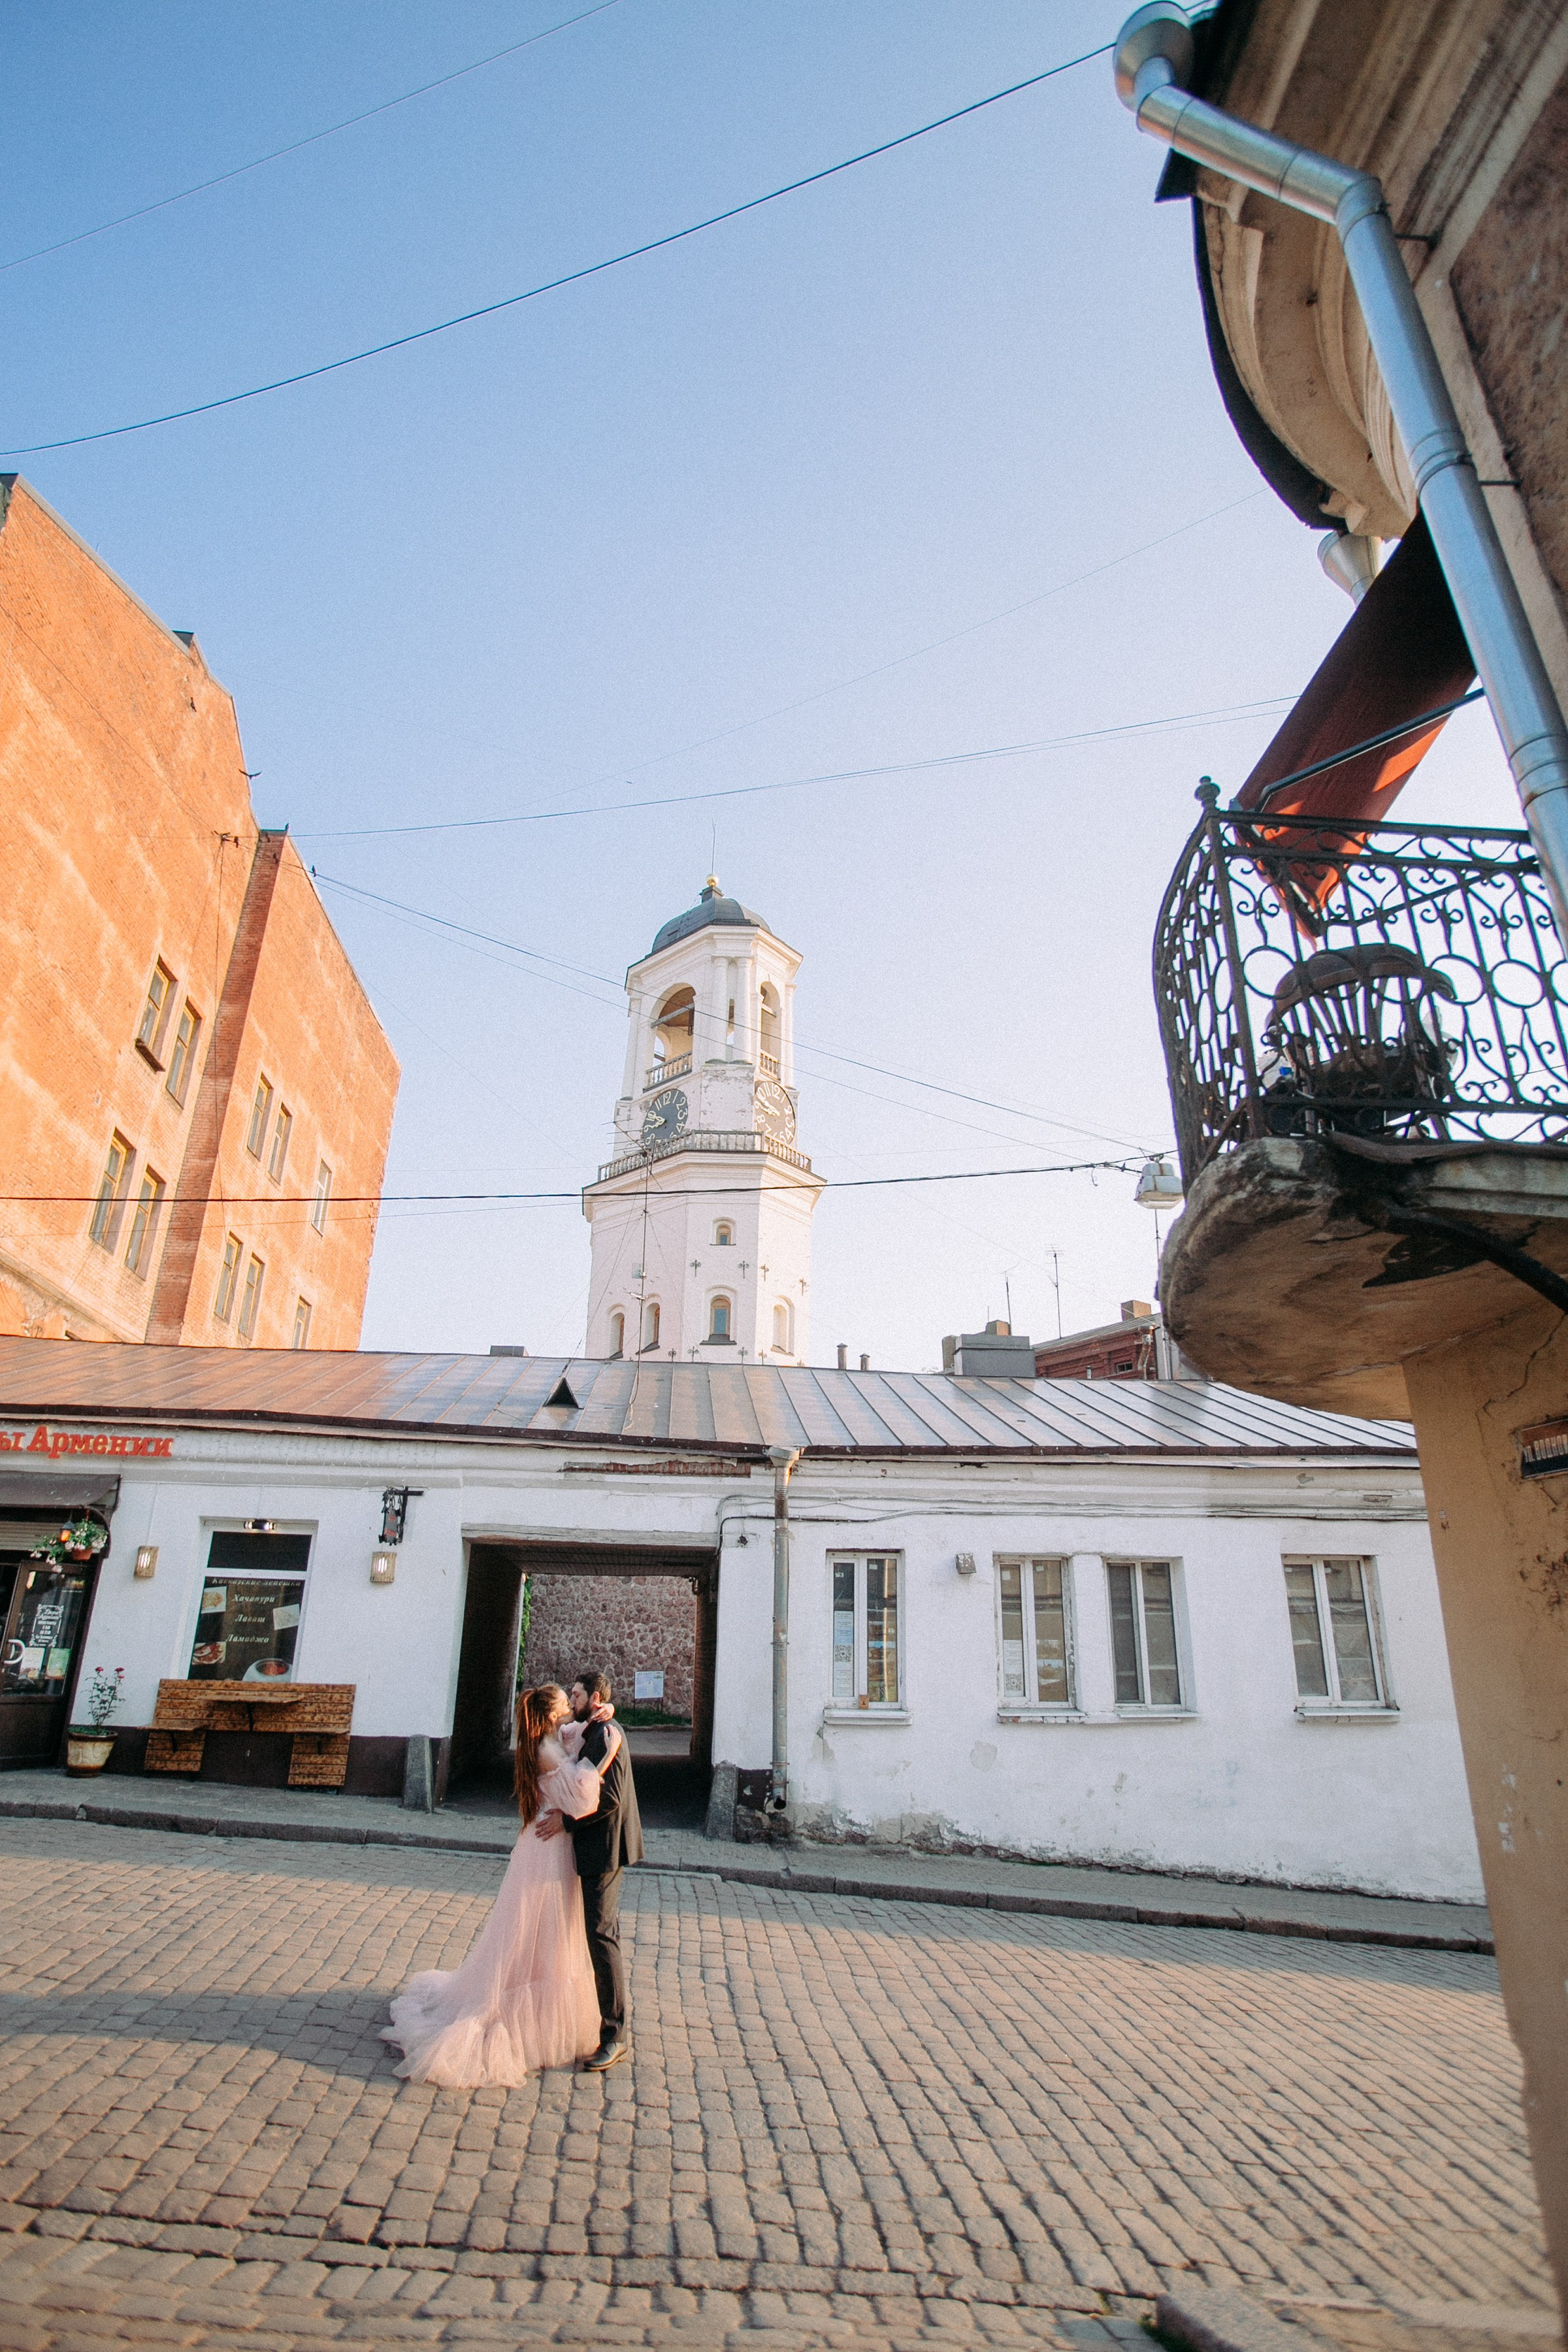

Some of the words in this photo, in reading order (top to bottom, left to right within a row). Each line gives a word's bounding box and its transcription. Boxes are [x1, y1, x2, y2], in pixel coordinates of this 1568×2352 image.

[672, 1090, 679, 1103] 1
[772, 1083, 780, 1100] 12
[663, 1091, 672, 1106] 12
[676, 1097, 686, 1111] 2
[780, 1094, 786, 1103] 1
[678, 1108, 687, 1120] 3
[784, 1105, 792, 1115] 2
[757, 1115, 765, 1124] 8
[785, 1117, 794, 1128] 3
[676, 1122, 685, 1134] 4
[785, 1127, 794, 1140] 4
[645, 1134, 655, 1145] 8
[27, 1425, 174, 1459] Армении
[232, 1593, 276, 1605] Хачапури
[235, 1614, 266, 1623] Лаваш
[225, 1634, 270, 1643] Ламаджо
